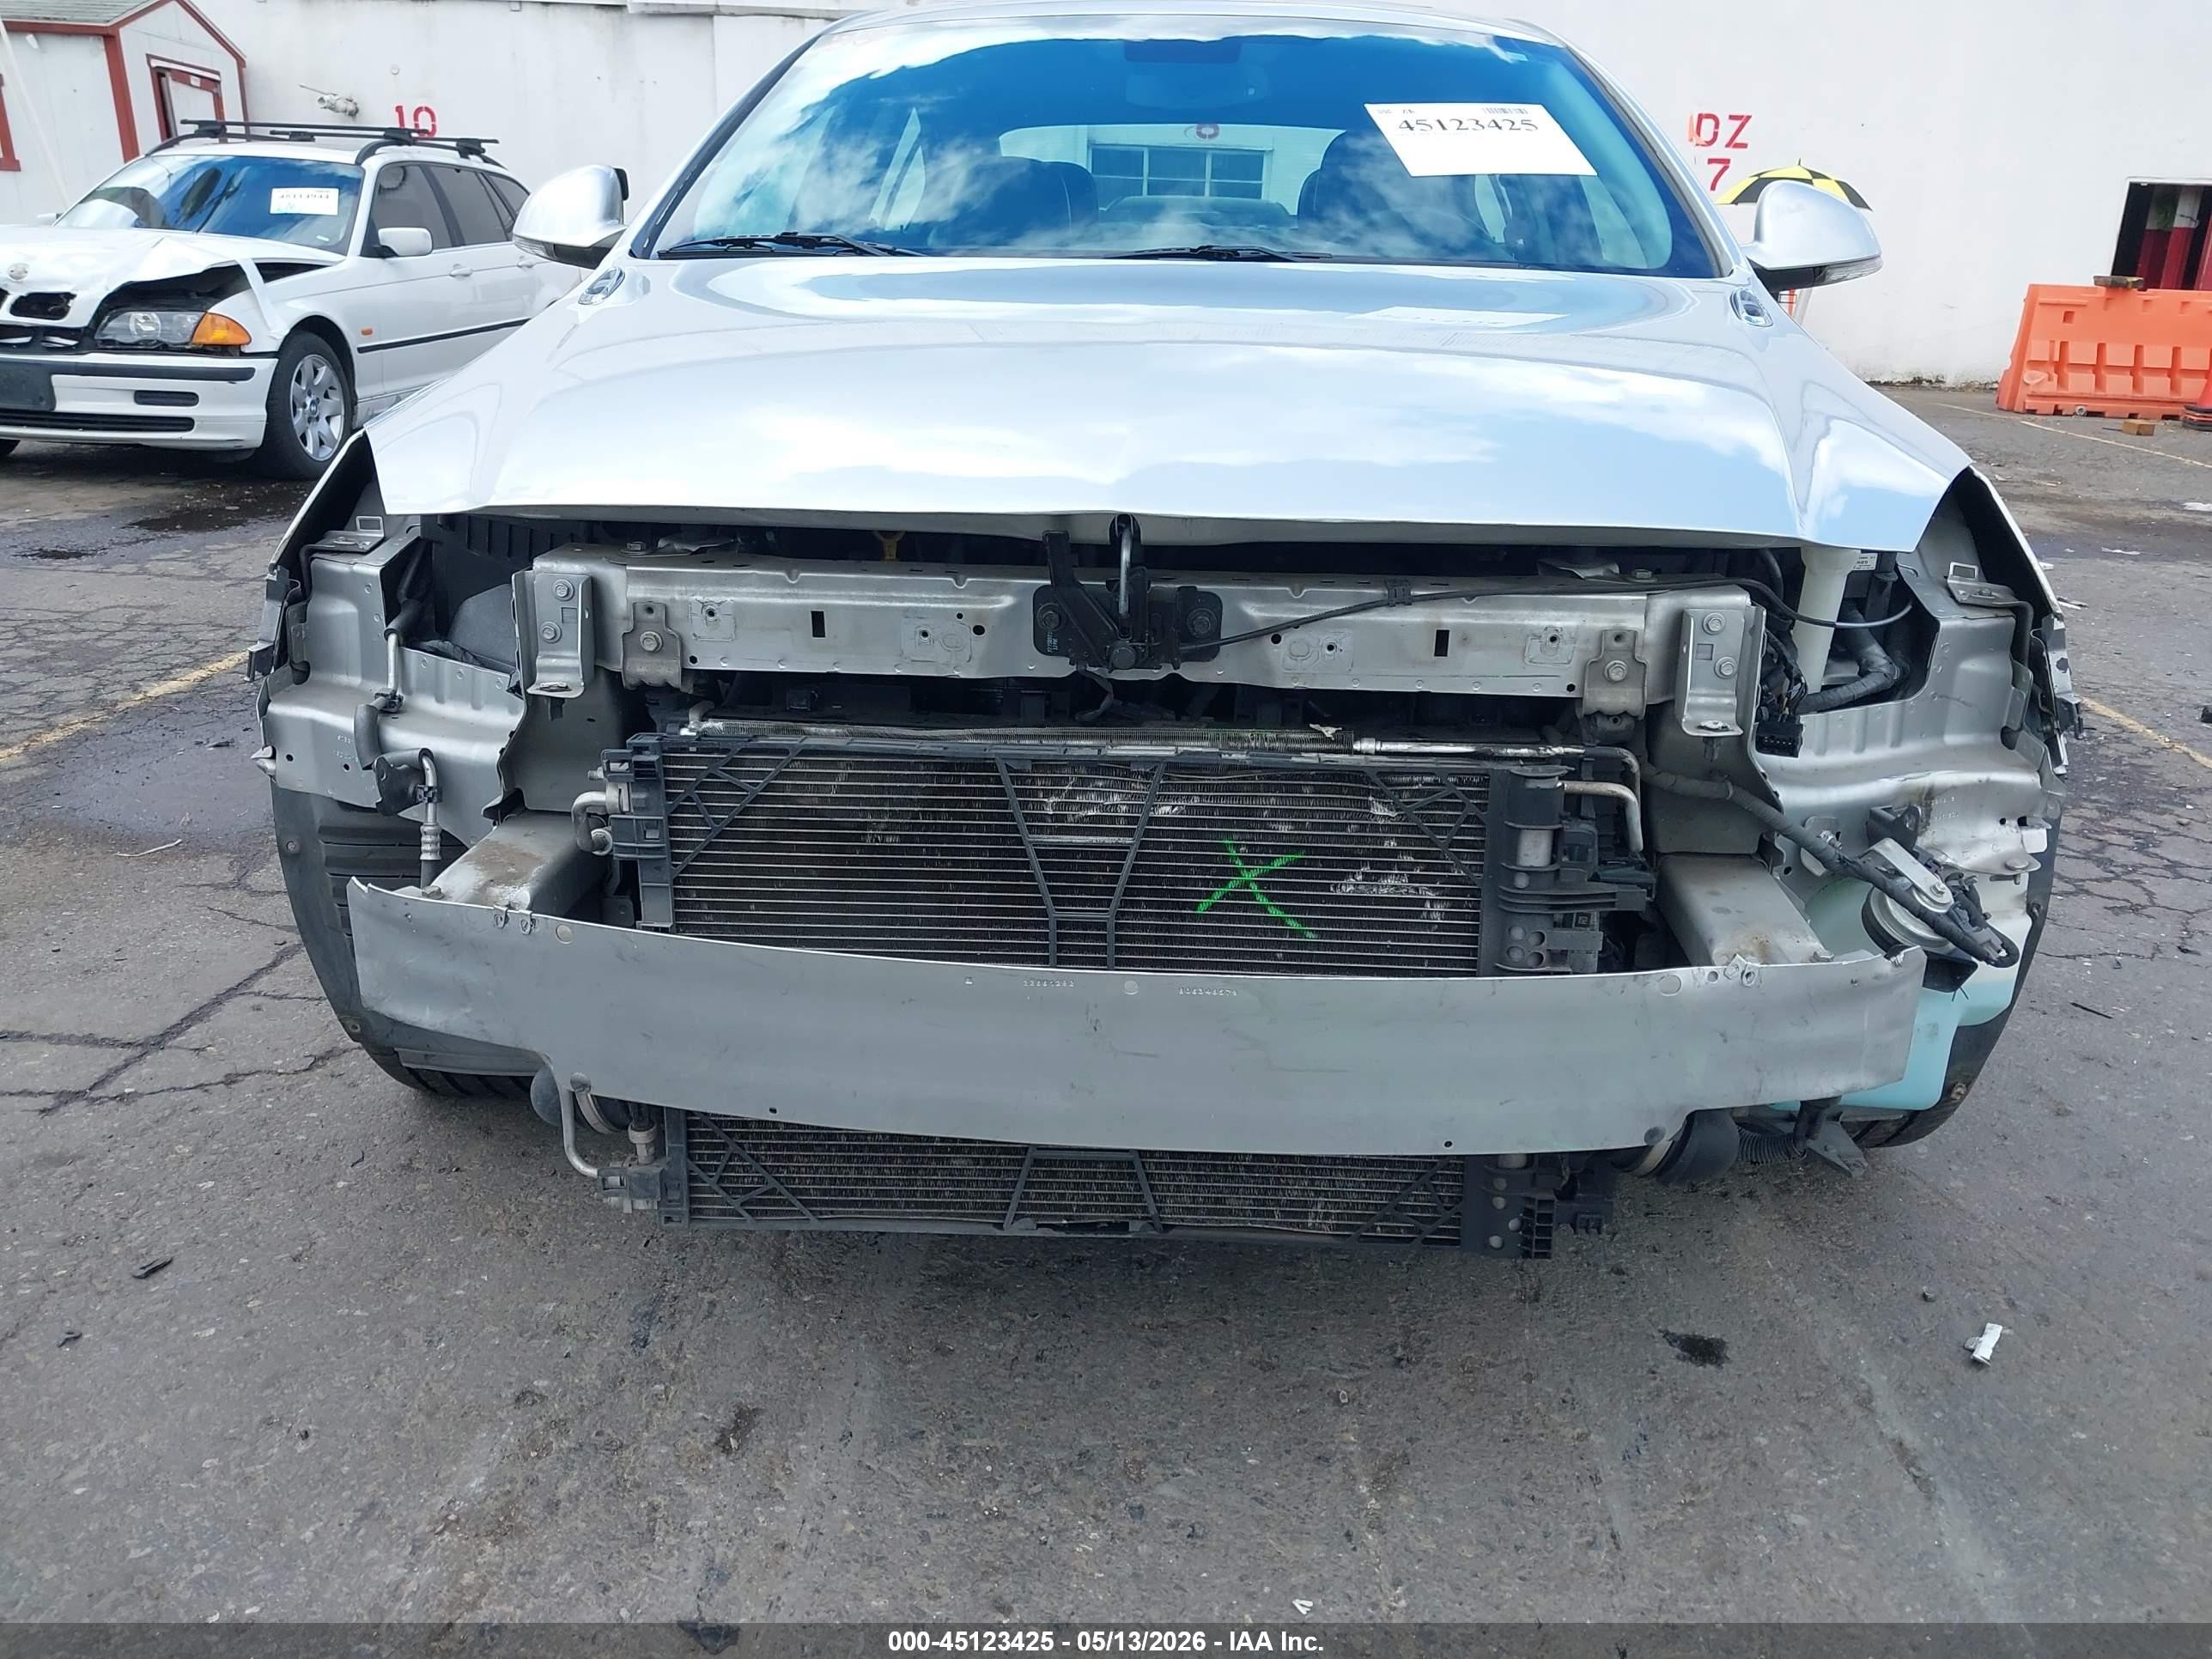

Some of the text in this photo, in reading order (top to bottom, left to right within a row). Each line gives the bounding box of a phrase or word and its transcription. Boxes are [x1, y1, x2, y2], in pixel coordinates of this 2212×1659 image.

[395, 106, 437, 137] 10
[1399, 118, 1539, 131] 45123425
[1707, 158, 1731, 191] 7
